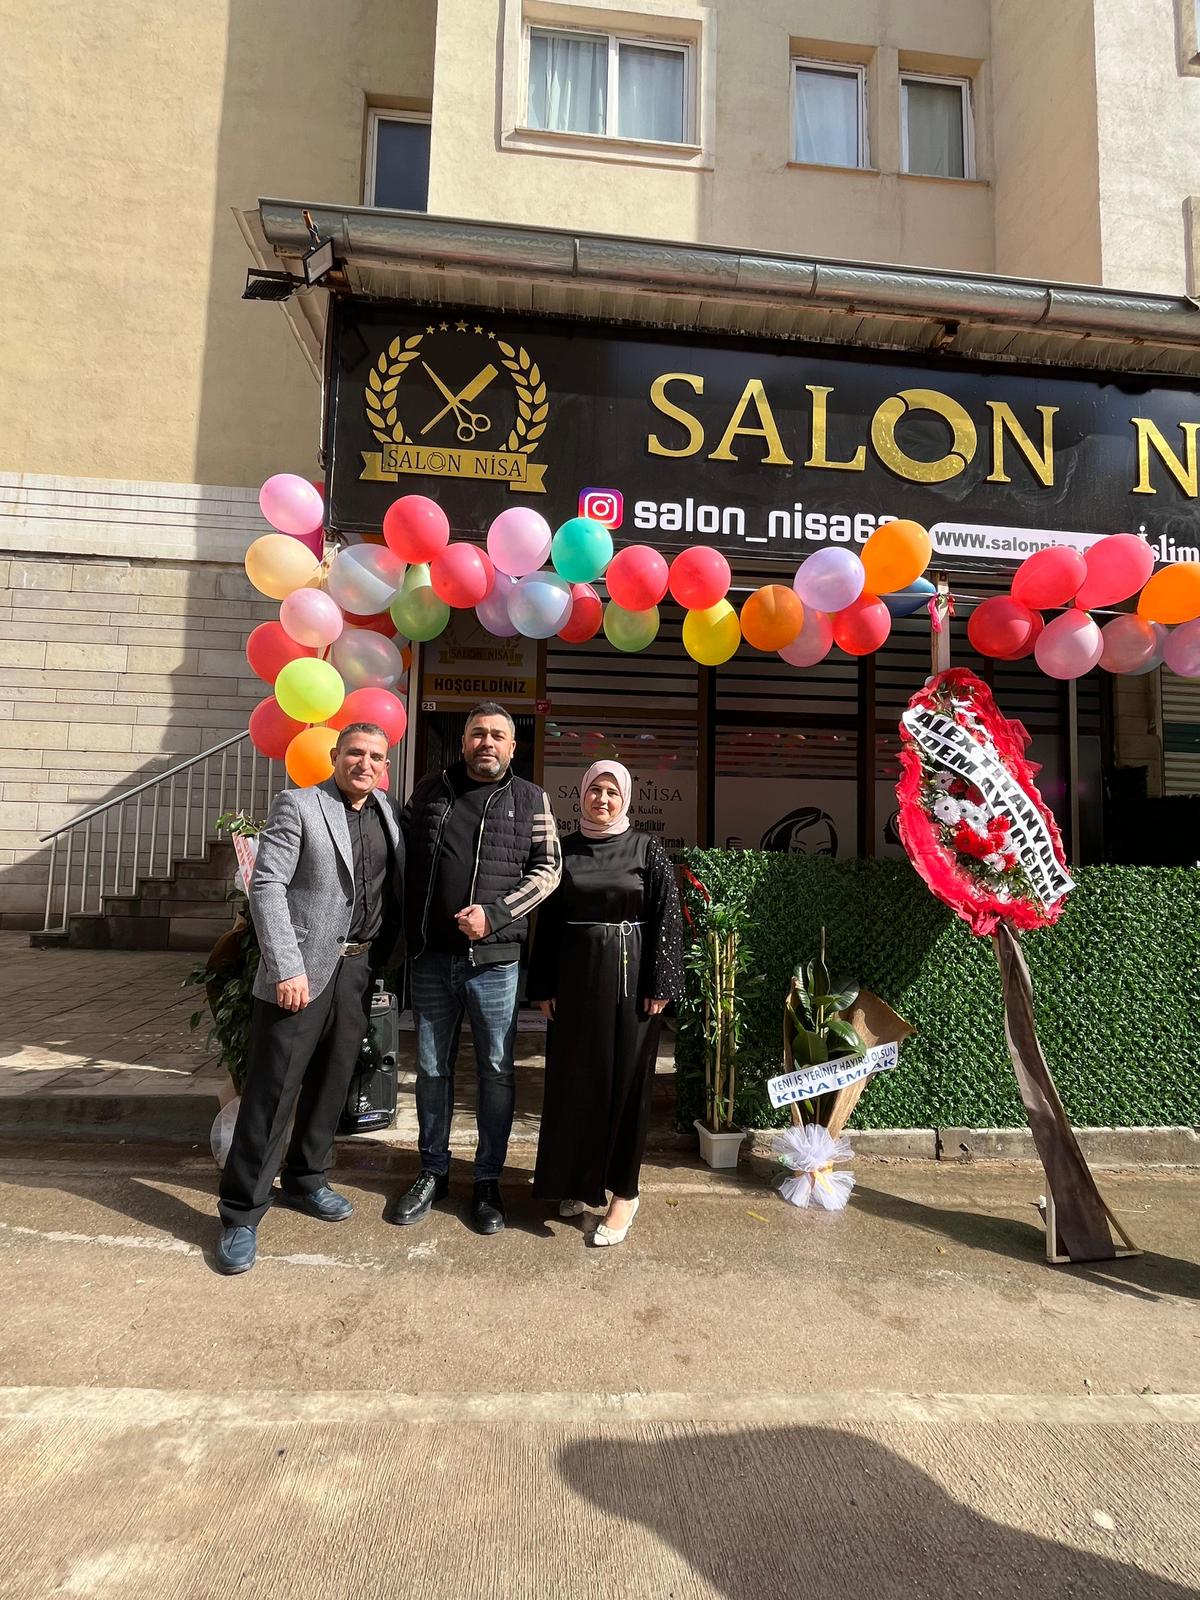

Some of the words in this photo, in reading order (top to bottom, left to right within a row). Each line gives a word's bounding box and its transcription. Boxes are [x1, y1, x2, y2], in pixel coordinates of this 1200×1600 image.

[647, 372, 1060, 487] SALON
[386, 447, 462, 474] SALON
[474, 453, 523, 478] NİSA
[633, 497, 900, 544] salon_nisa6
[423, 702, 434, 710] 25
[434, 677, 527, 694] HOŞGELDİNİZ
[908, 723, 979, 776] ADEM
[914, 711, 976, 753] ALEX
[639, 785, 683, 801] NİSA
[635, 820, 665, 832] Pedikür
[772, 1076, 793, 1092] YENİ
[804, 1064, 838, 1083] YERİNİZ
[871, 1045, 896, 1062] OLSUN
[776, 1082, 830, 1104] KINA
[837, 1057, 896, 1087] EMLAK
